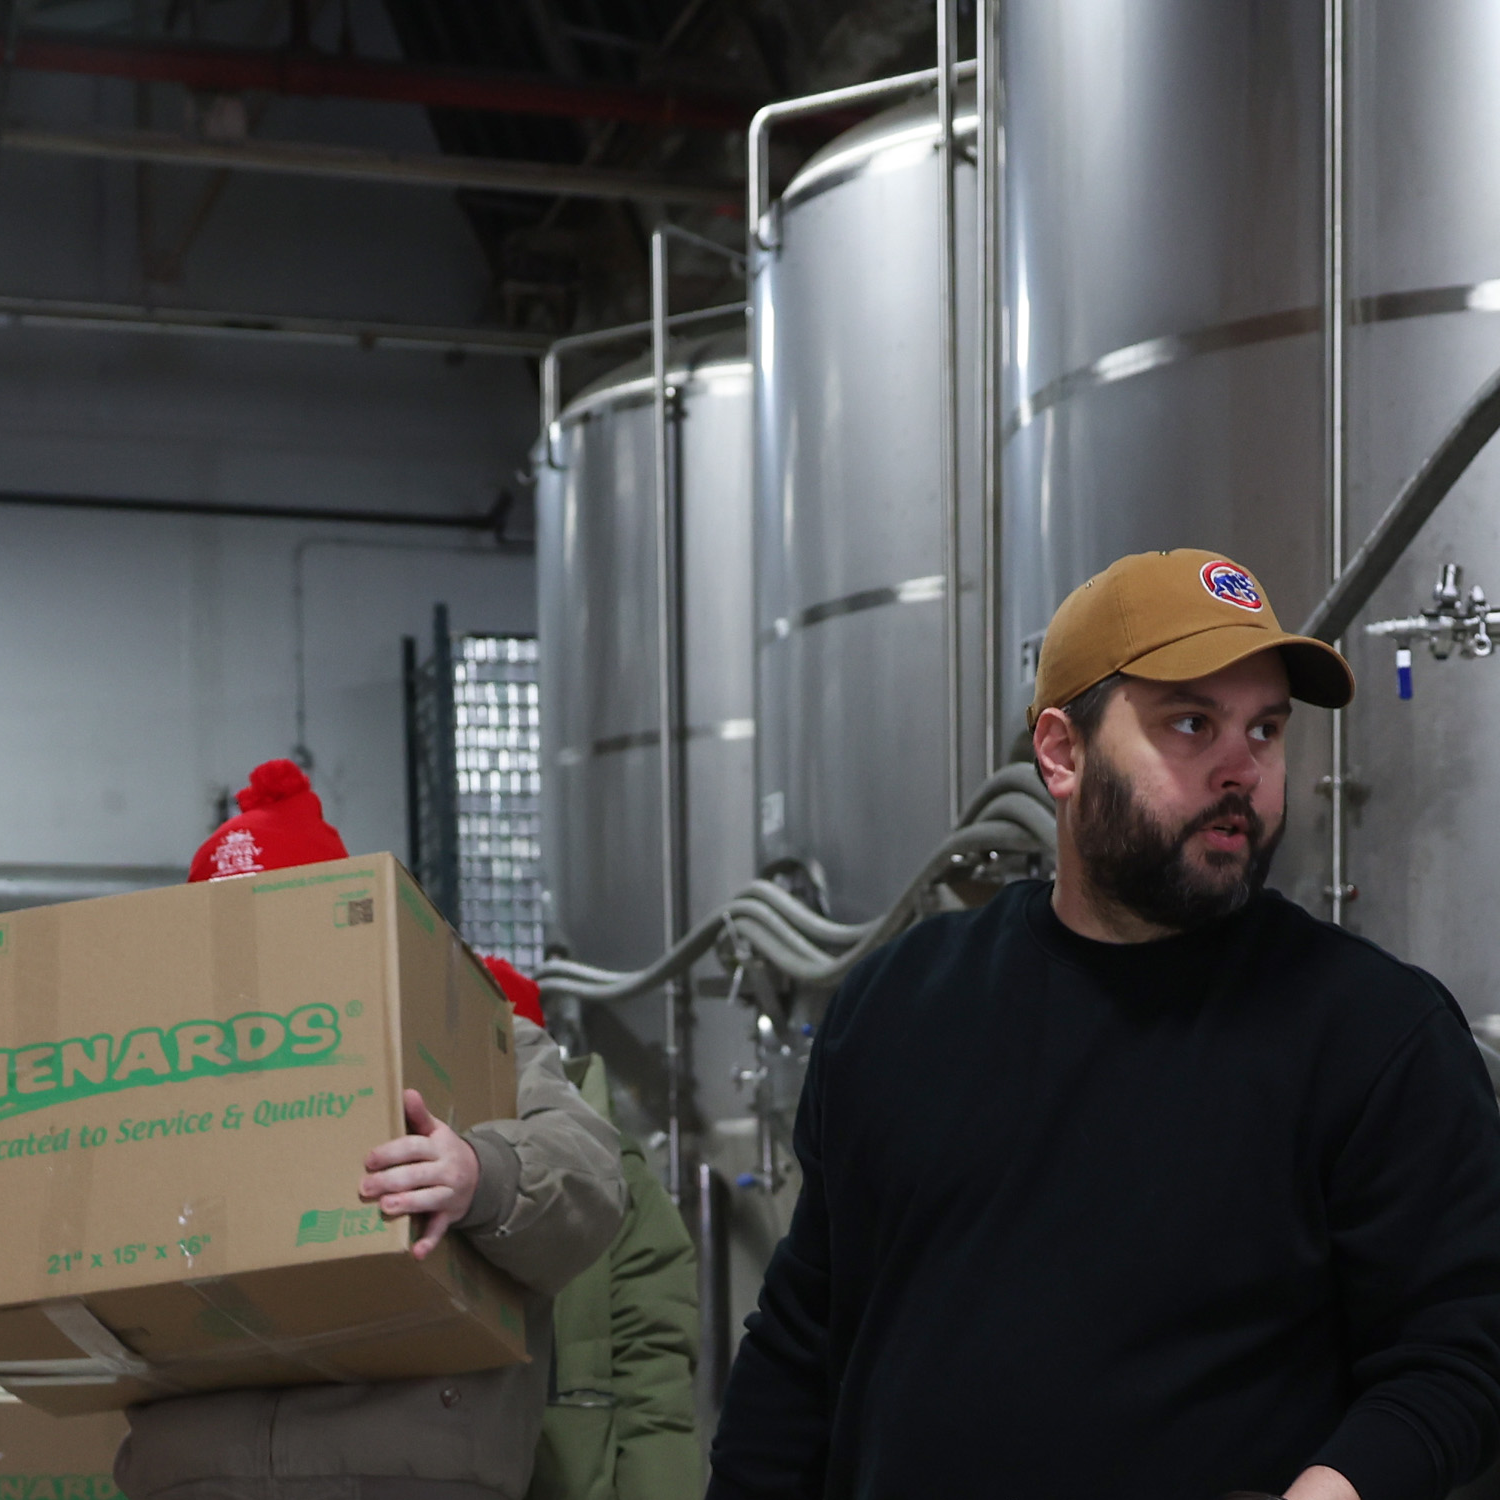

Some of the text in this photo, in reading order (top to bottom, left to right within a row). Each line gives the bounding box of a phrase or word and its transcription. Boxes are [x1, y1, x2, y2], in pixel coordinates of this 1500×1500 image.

[80, 1119, 107, 1148] to
[116, 1106, 214, 1145] Service
[221, 1103, 244, 1129] &
[252, 1090, 355, 1128] Quality
[46, 1250, 83, 1275] 21"
[90, 1253, 103, 1269] x
[113, 1243, 148, 1265] 15"
[154, 1244, 168, 1261] x
